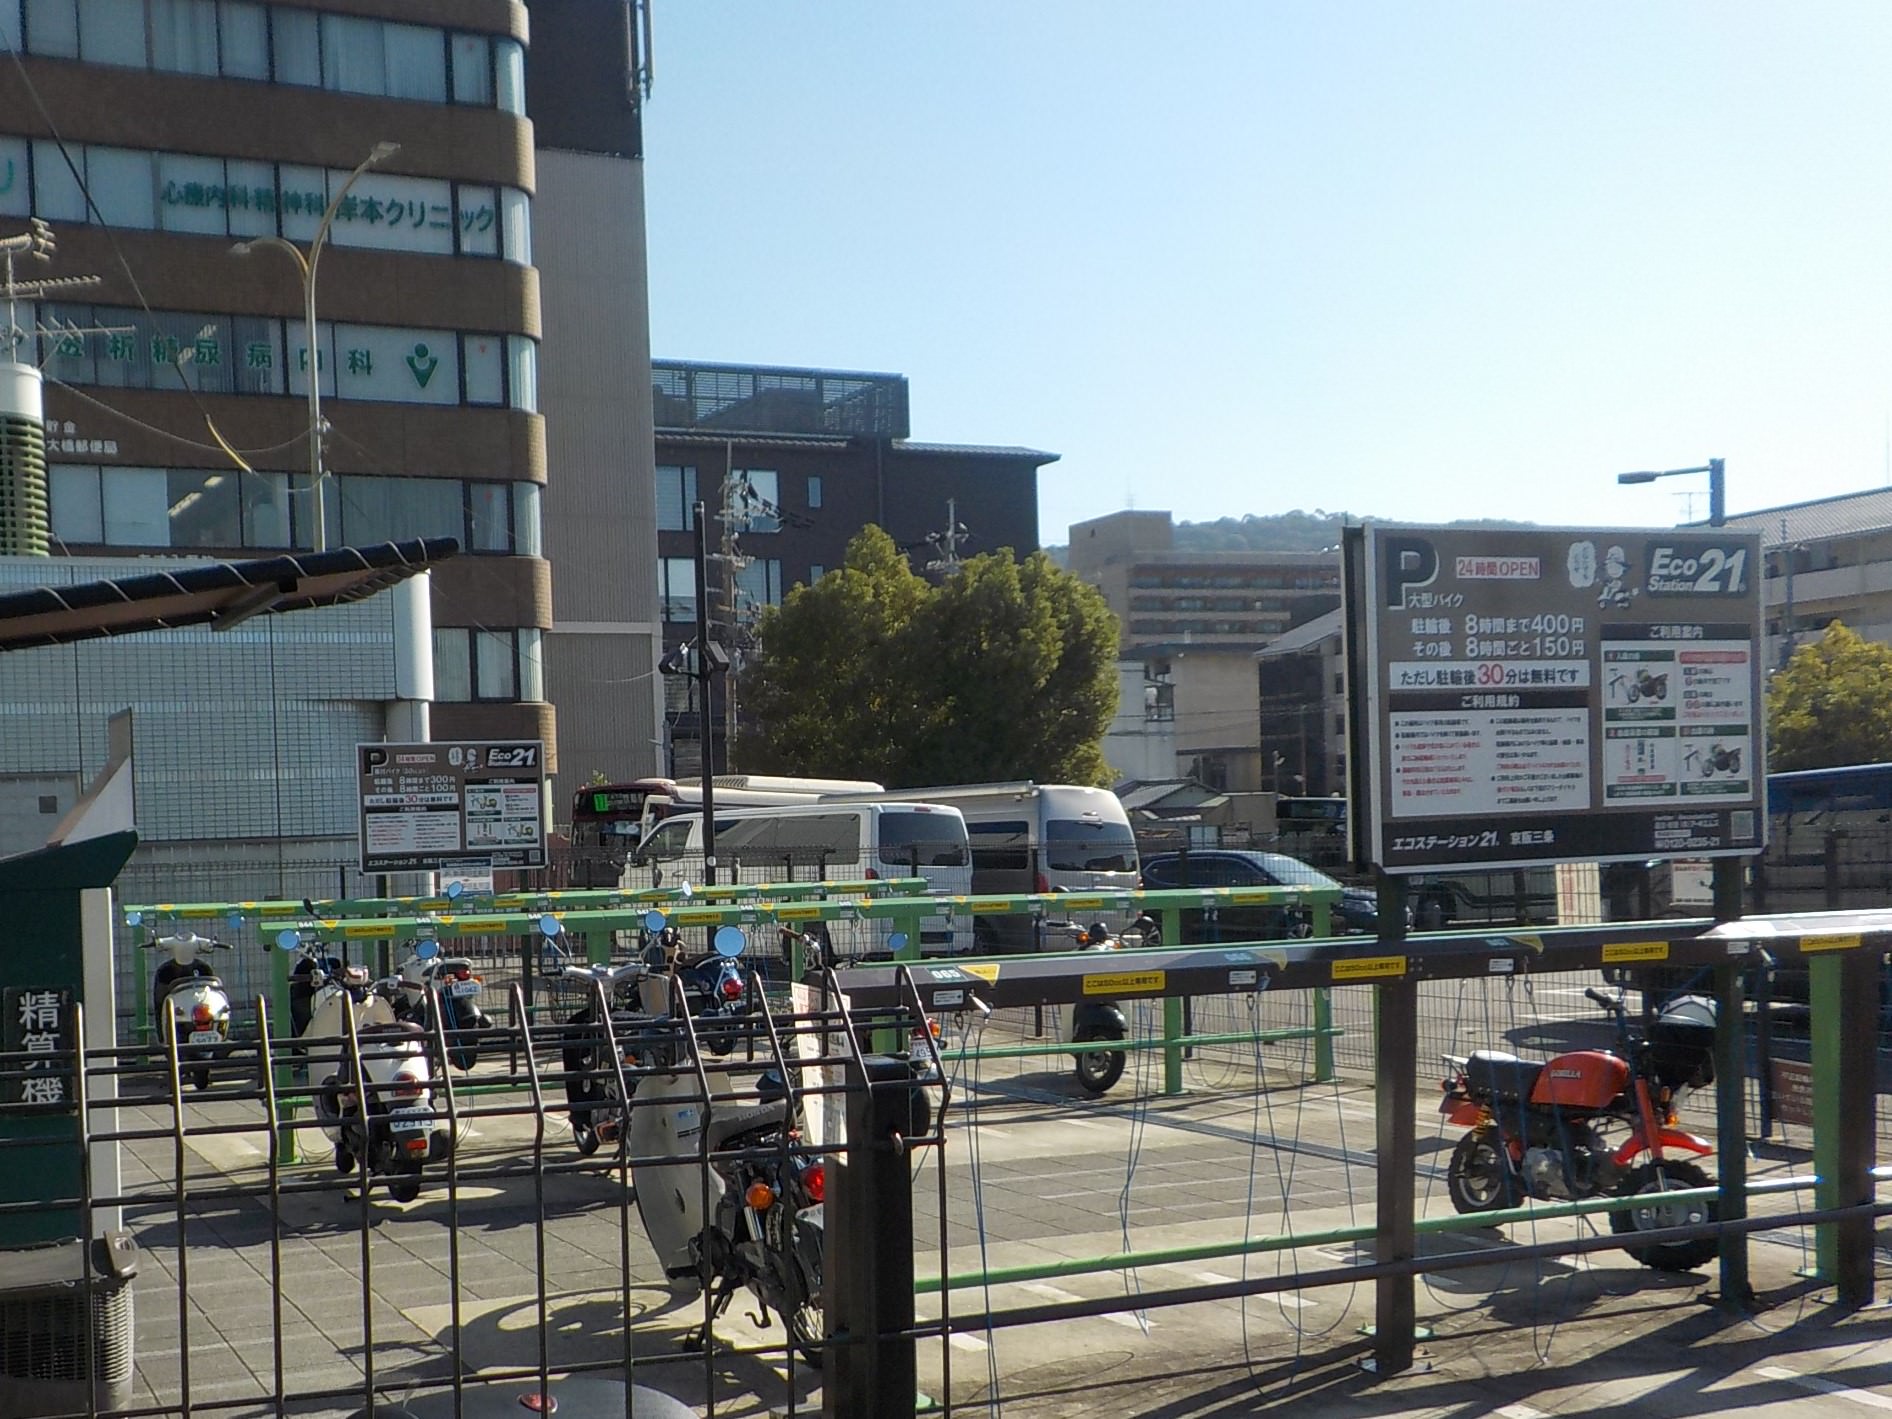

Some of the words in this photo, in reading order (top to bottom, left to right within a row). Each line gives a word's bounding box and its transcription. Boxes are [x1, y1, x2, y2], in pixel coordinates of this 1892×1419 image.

[1458, 559, 1539, 577] 24時間OPEN
[1651, 547, 1698, 576] Eco
[1694, 548, 1747, 593] 21
[1647, 576, 1695, 592] Station
[1408, 592, 1465, 609] 大型バイク
[1465, 613, 1585, 635] 8時間まで400円
[1412, 640, 1453, 658] その後
[1465, 636, 1586, 658] 8時間ごと150円
[1399, 662, 1581, 686] ただし駐輪後30分は無料です
[488, 748, 512, 760] Eco
[510, 748, 536, 766] 21
[19, 990, 64, 1104] 精算機
